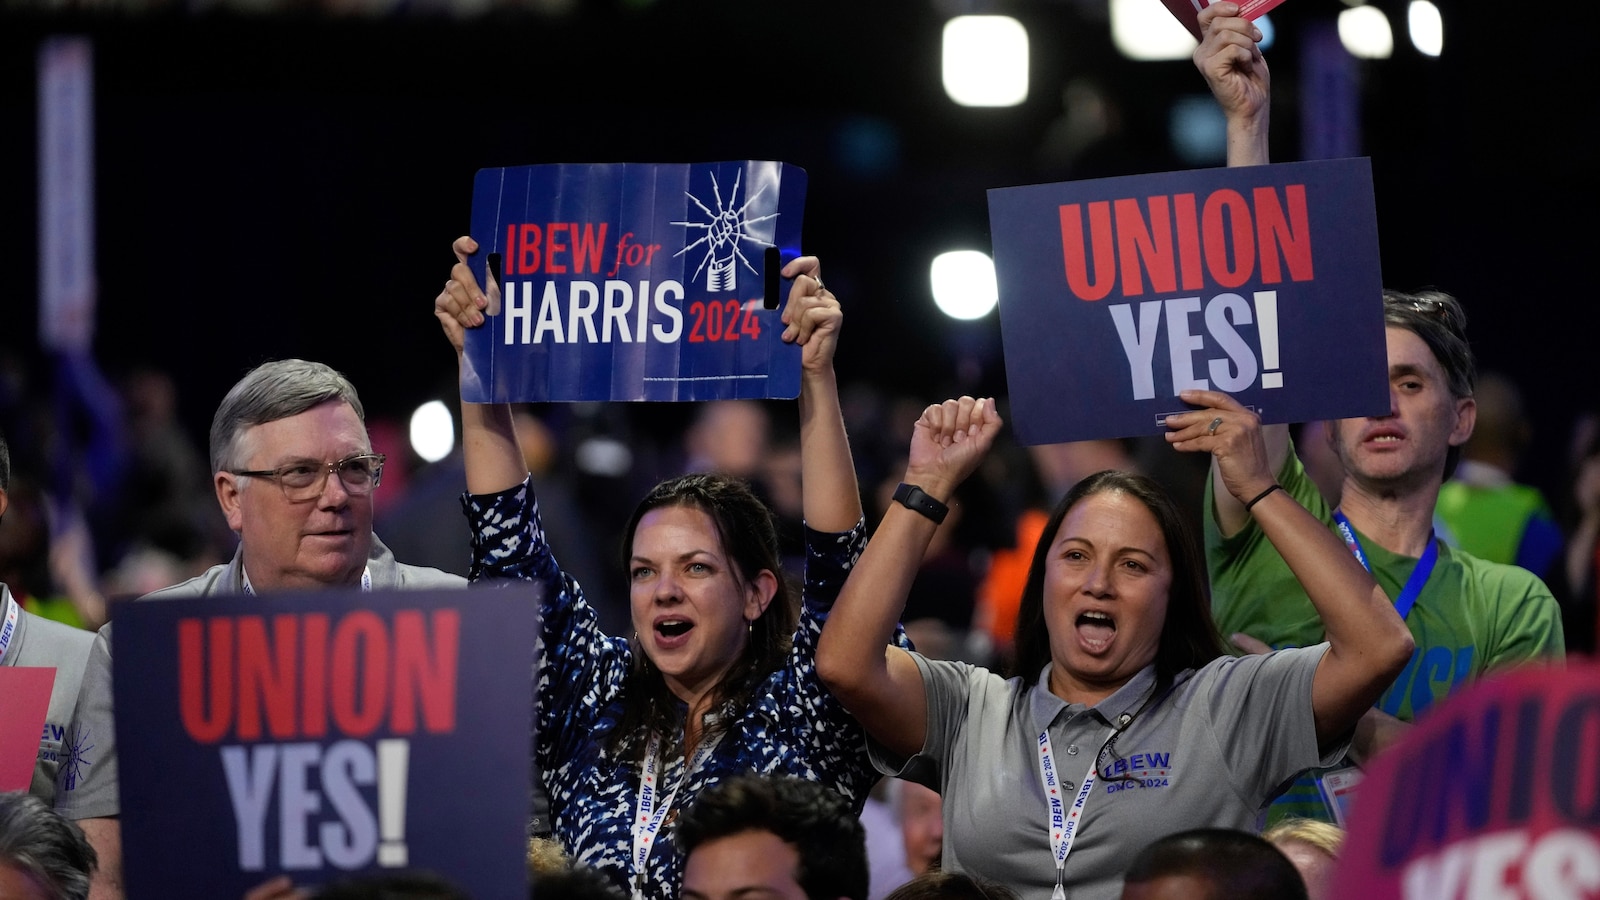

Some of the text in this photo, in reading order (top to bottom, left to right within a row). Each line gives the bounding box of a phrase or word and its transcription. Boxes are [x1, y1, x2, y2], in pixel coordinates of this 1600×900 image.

[505, 222, 662, 277] IBEW for
[1059, 184, 1314, 301] UNION
[504, 279, 761, 345] HARRIS 2024
[1108, 290, 1284, 401] YES!
[178, 608, 461, 744] UNION
[640, 784, 653, 813] IBEW
[1044, 755, 1063, 829] IBEW DNC 2024
[1103, 752, 1170, 778] IBEW
[1106, 778, 1169, 794] DNC 2024
[221, 738, 410, 872] YES!
[646, 804, 668, 833] IBEW
[1058, 778, 1094, 861] IBEW DNC 2024
